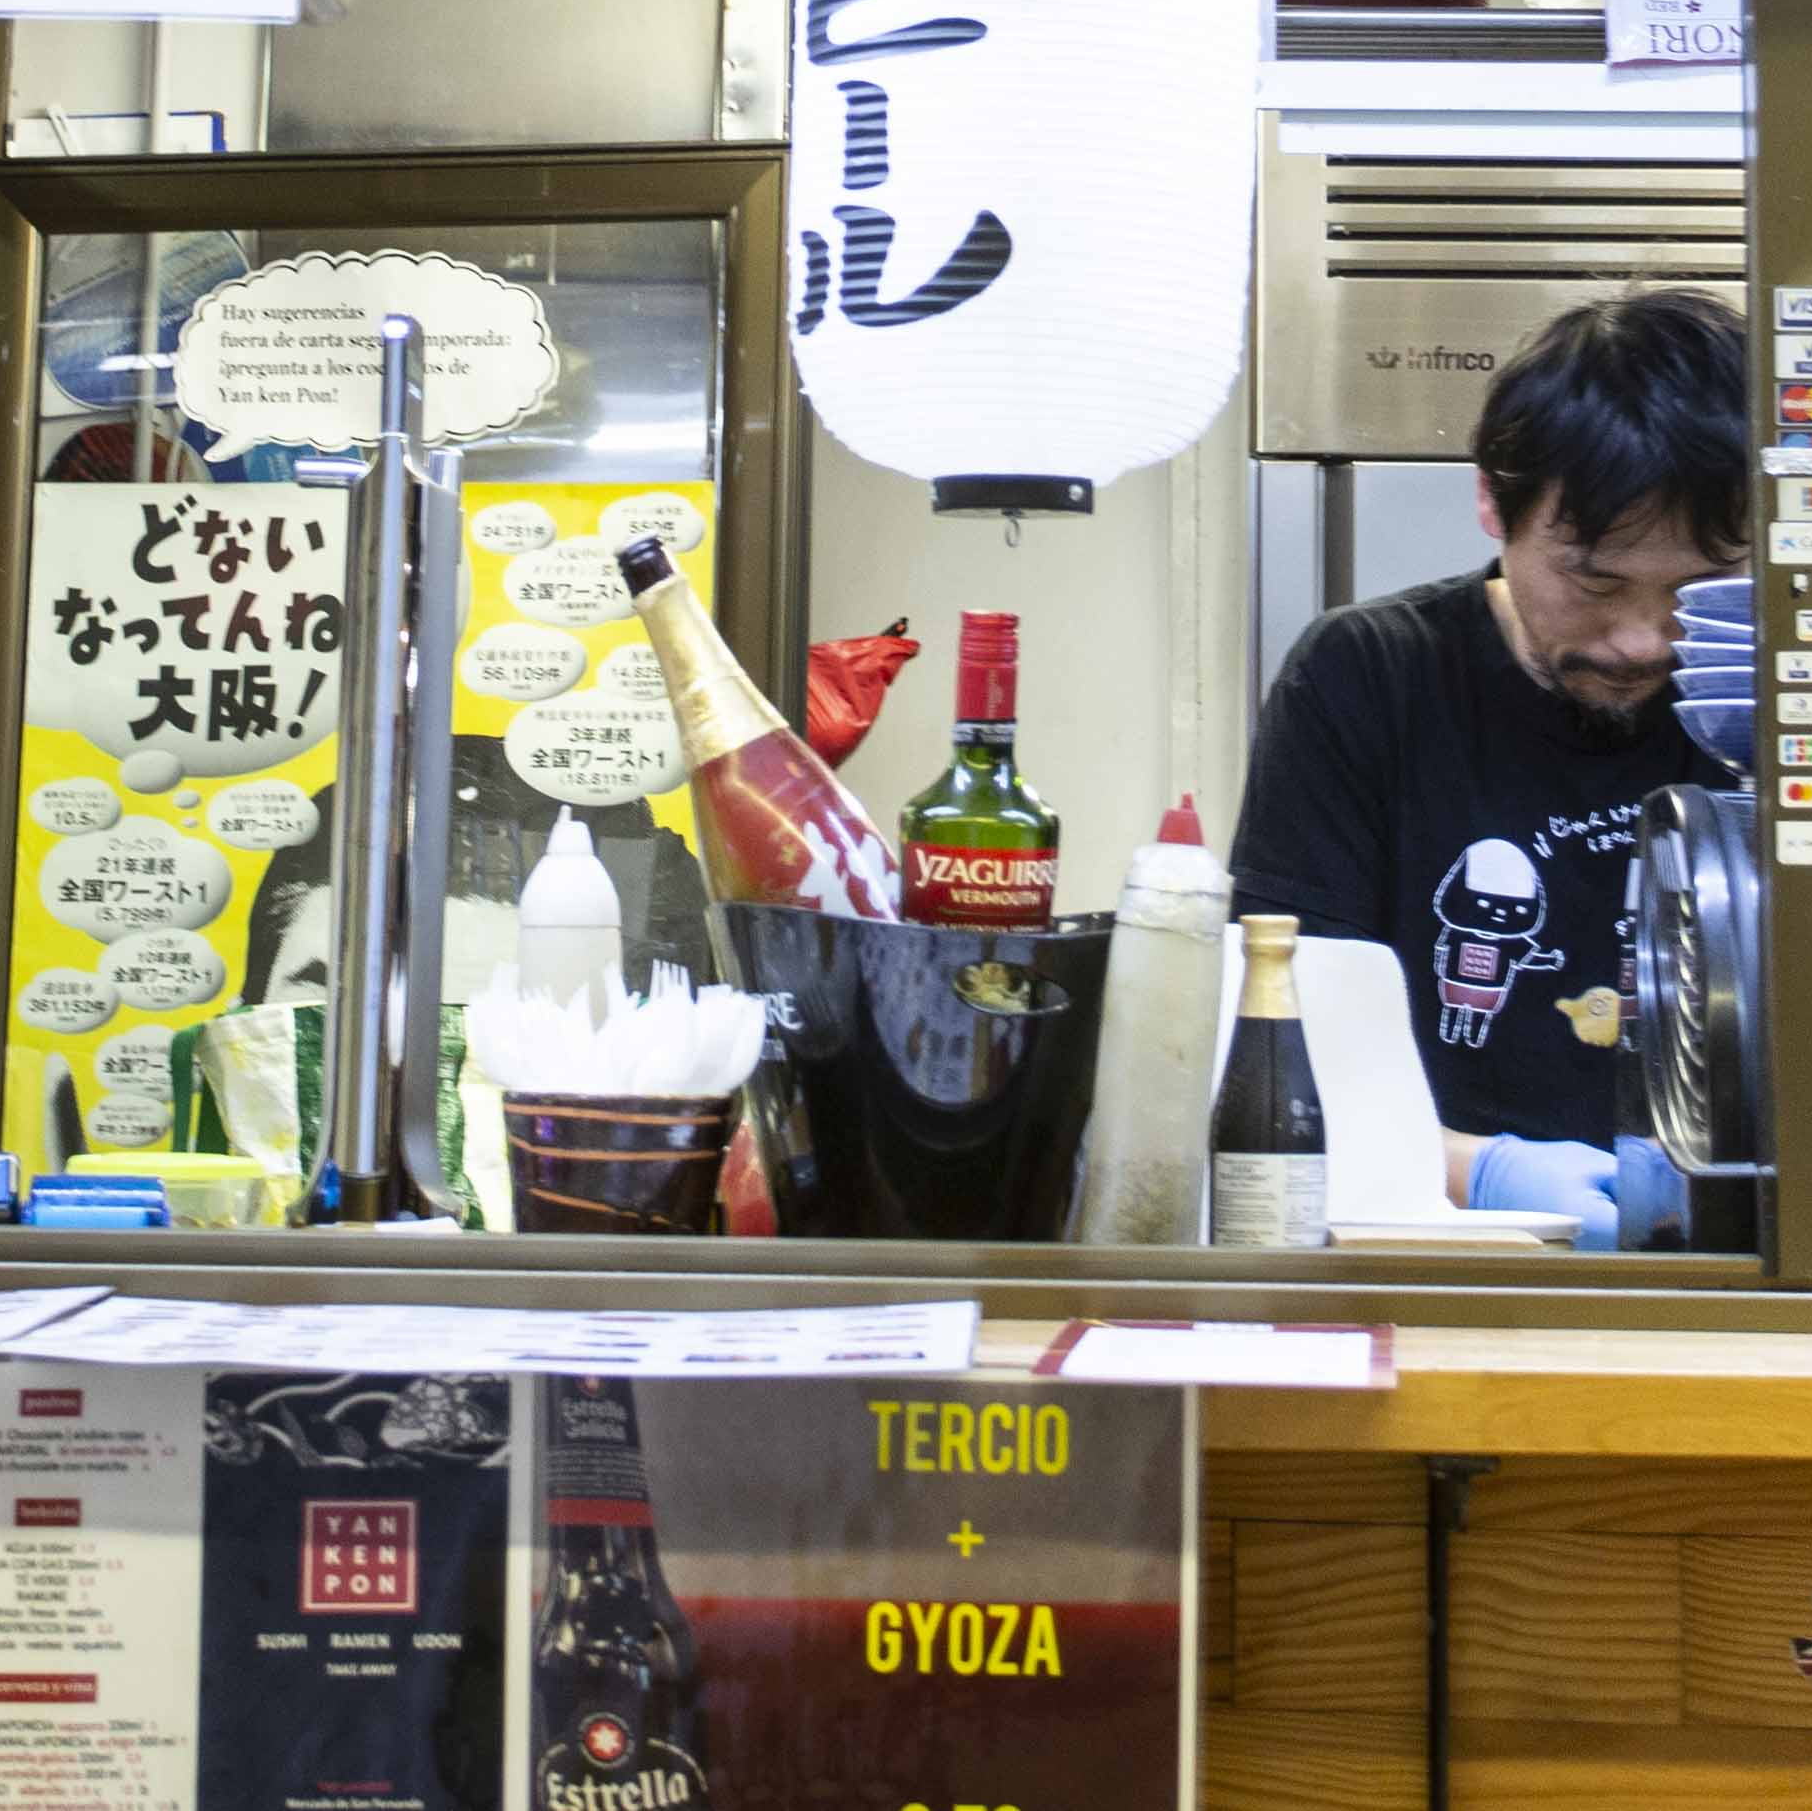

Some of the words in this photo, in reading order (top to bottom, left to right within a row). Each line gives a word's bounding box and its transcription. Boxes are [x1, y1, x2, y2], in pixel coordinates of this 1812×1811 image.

[221, 305, 255, 322] Hay
[263, 304, 365, 323] sugerencias
[220, 334, 268, 348] fuera
[274, 334, 295, 348] de
[299, 335, 343, 348] carta
[131, 494, 324, 584] どない
[520, 583, 623, 601] 全国ワースト
[52, 590, 345, 666] なってんね
[949, 888, 1040, 906] VERMOUTH
[869, 1401, 1069, 1475] TERCIO
[325, 1516, 397, 1535] YAN
[324, 1545, 397, 1565] KEN
[324, 1574, 397, 1594] PON
[257, 1633, 308, 1650] SUSHI
[330, 1633, 391, 1650] RAMEN
[413, 1633, 462, 1650] UDON
[866, 1601, 1062, 1677] GYOZA
[547, 1768, 689, 1811] Estrella
